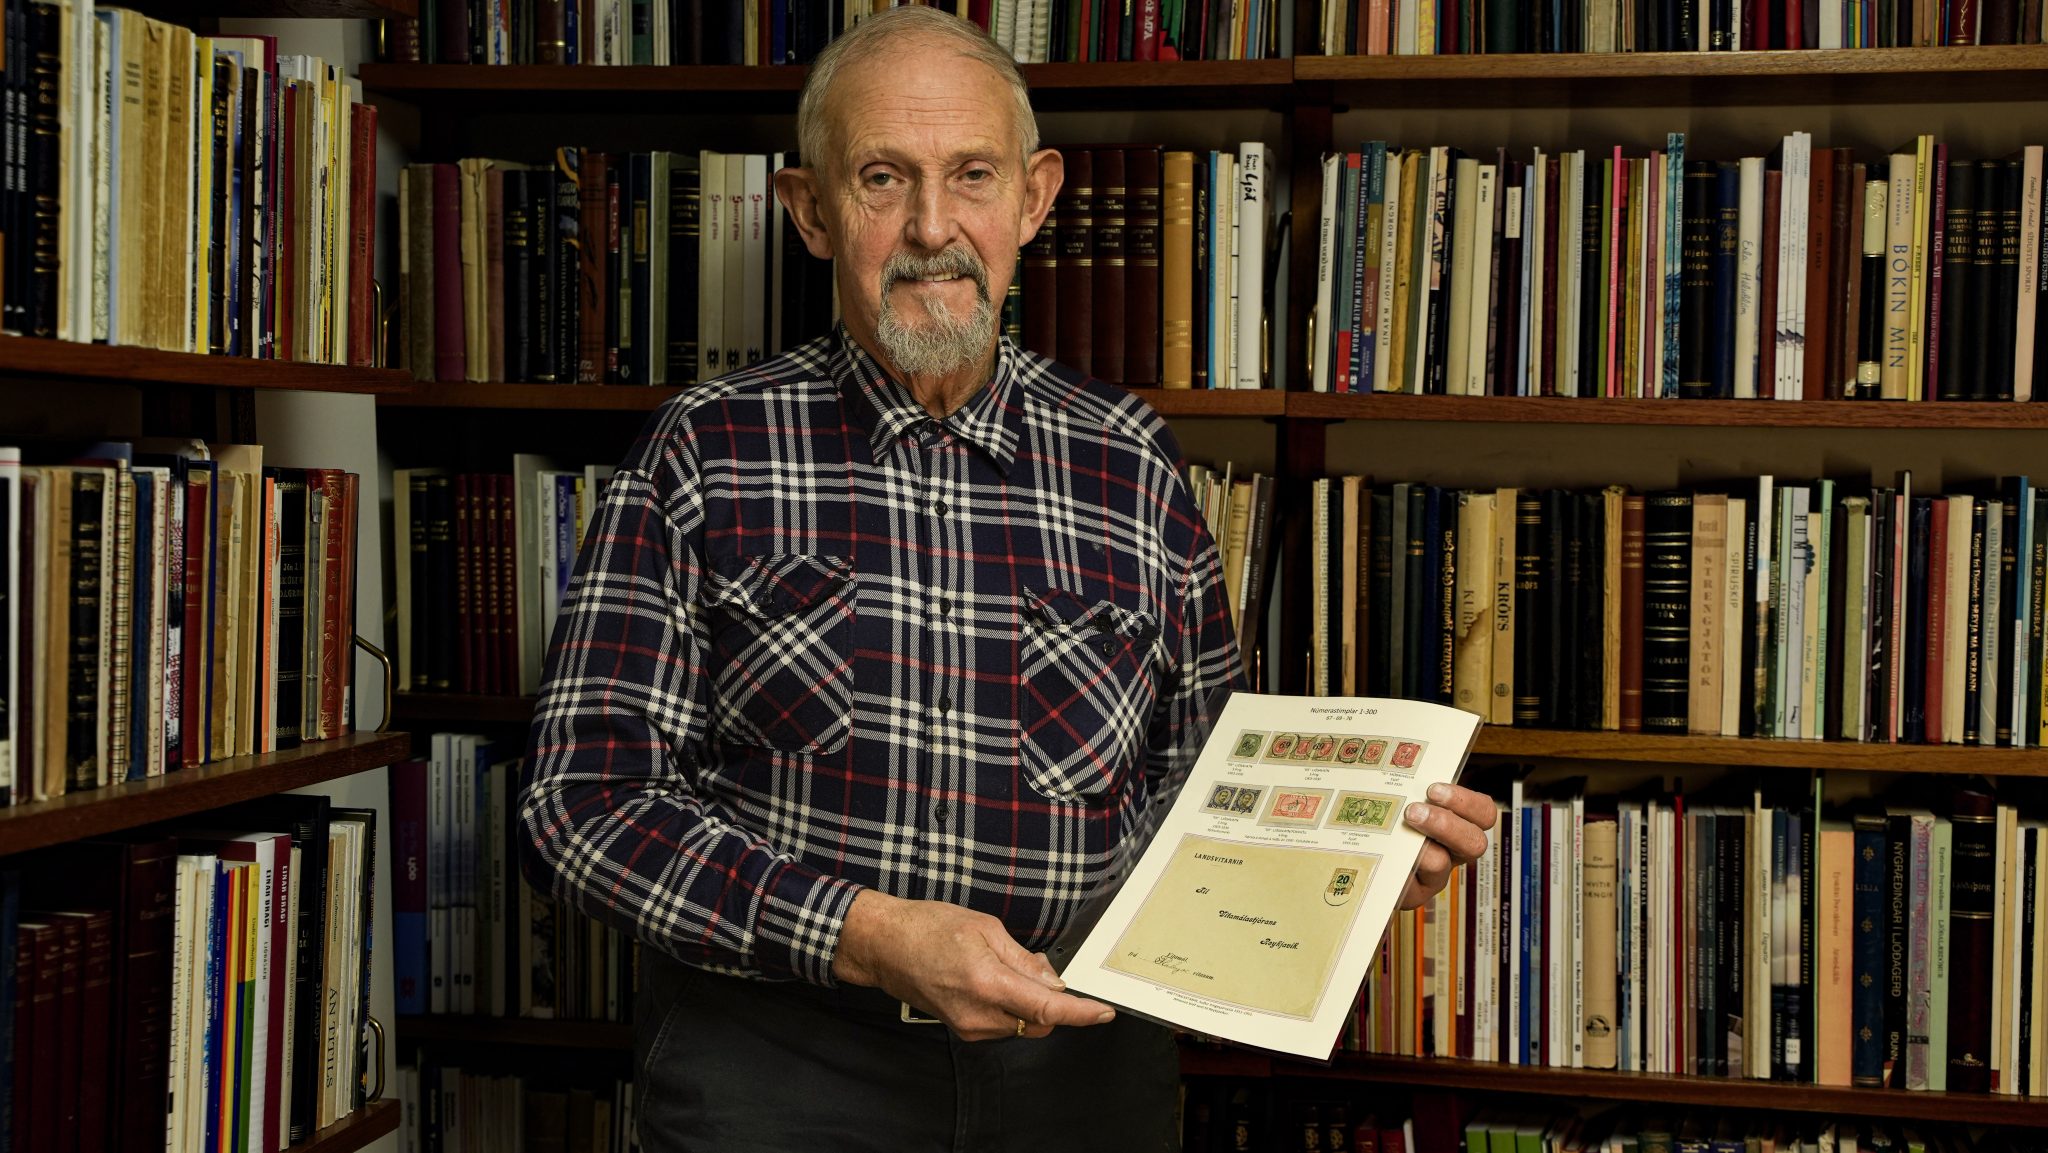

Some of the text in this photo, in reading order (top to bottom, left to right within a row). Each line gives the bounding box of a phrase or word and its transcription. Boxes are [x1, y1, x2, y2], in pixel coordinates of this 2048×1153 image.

[1361, 155, 1369, 171] Einar
[1356, 236, 1365, 246] TIL
[1934, 231, 1942, 253] FUGL
[1354, 280, 1362, 295] SEM
[1889, 245, 1909, 367] BÓKIN MÍN
[156, 525, 166, 567] DAN
[1793, 515, 1807, 561] RUMI
[1497, 582, 1512, 632] KRÖFS
[1194, 852, 1244, 865] LANDSVITARNIR
[1336, 875, 1350, 884] 20
[328, 988, 338, 1014] AN
[326, 1021, 336, 1088] TITILS
